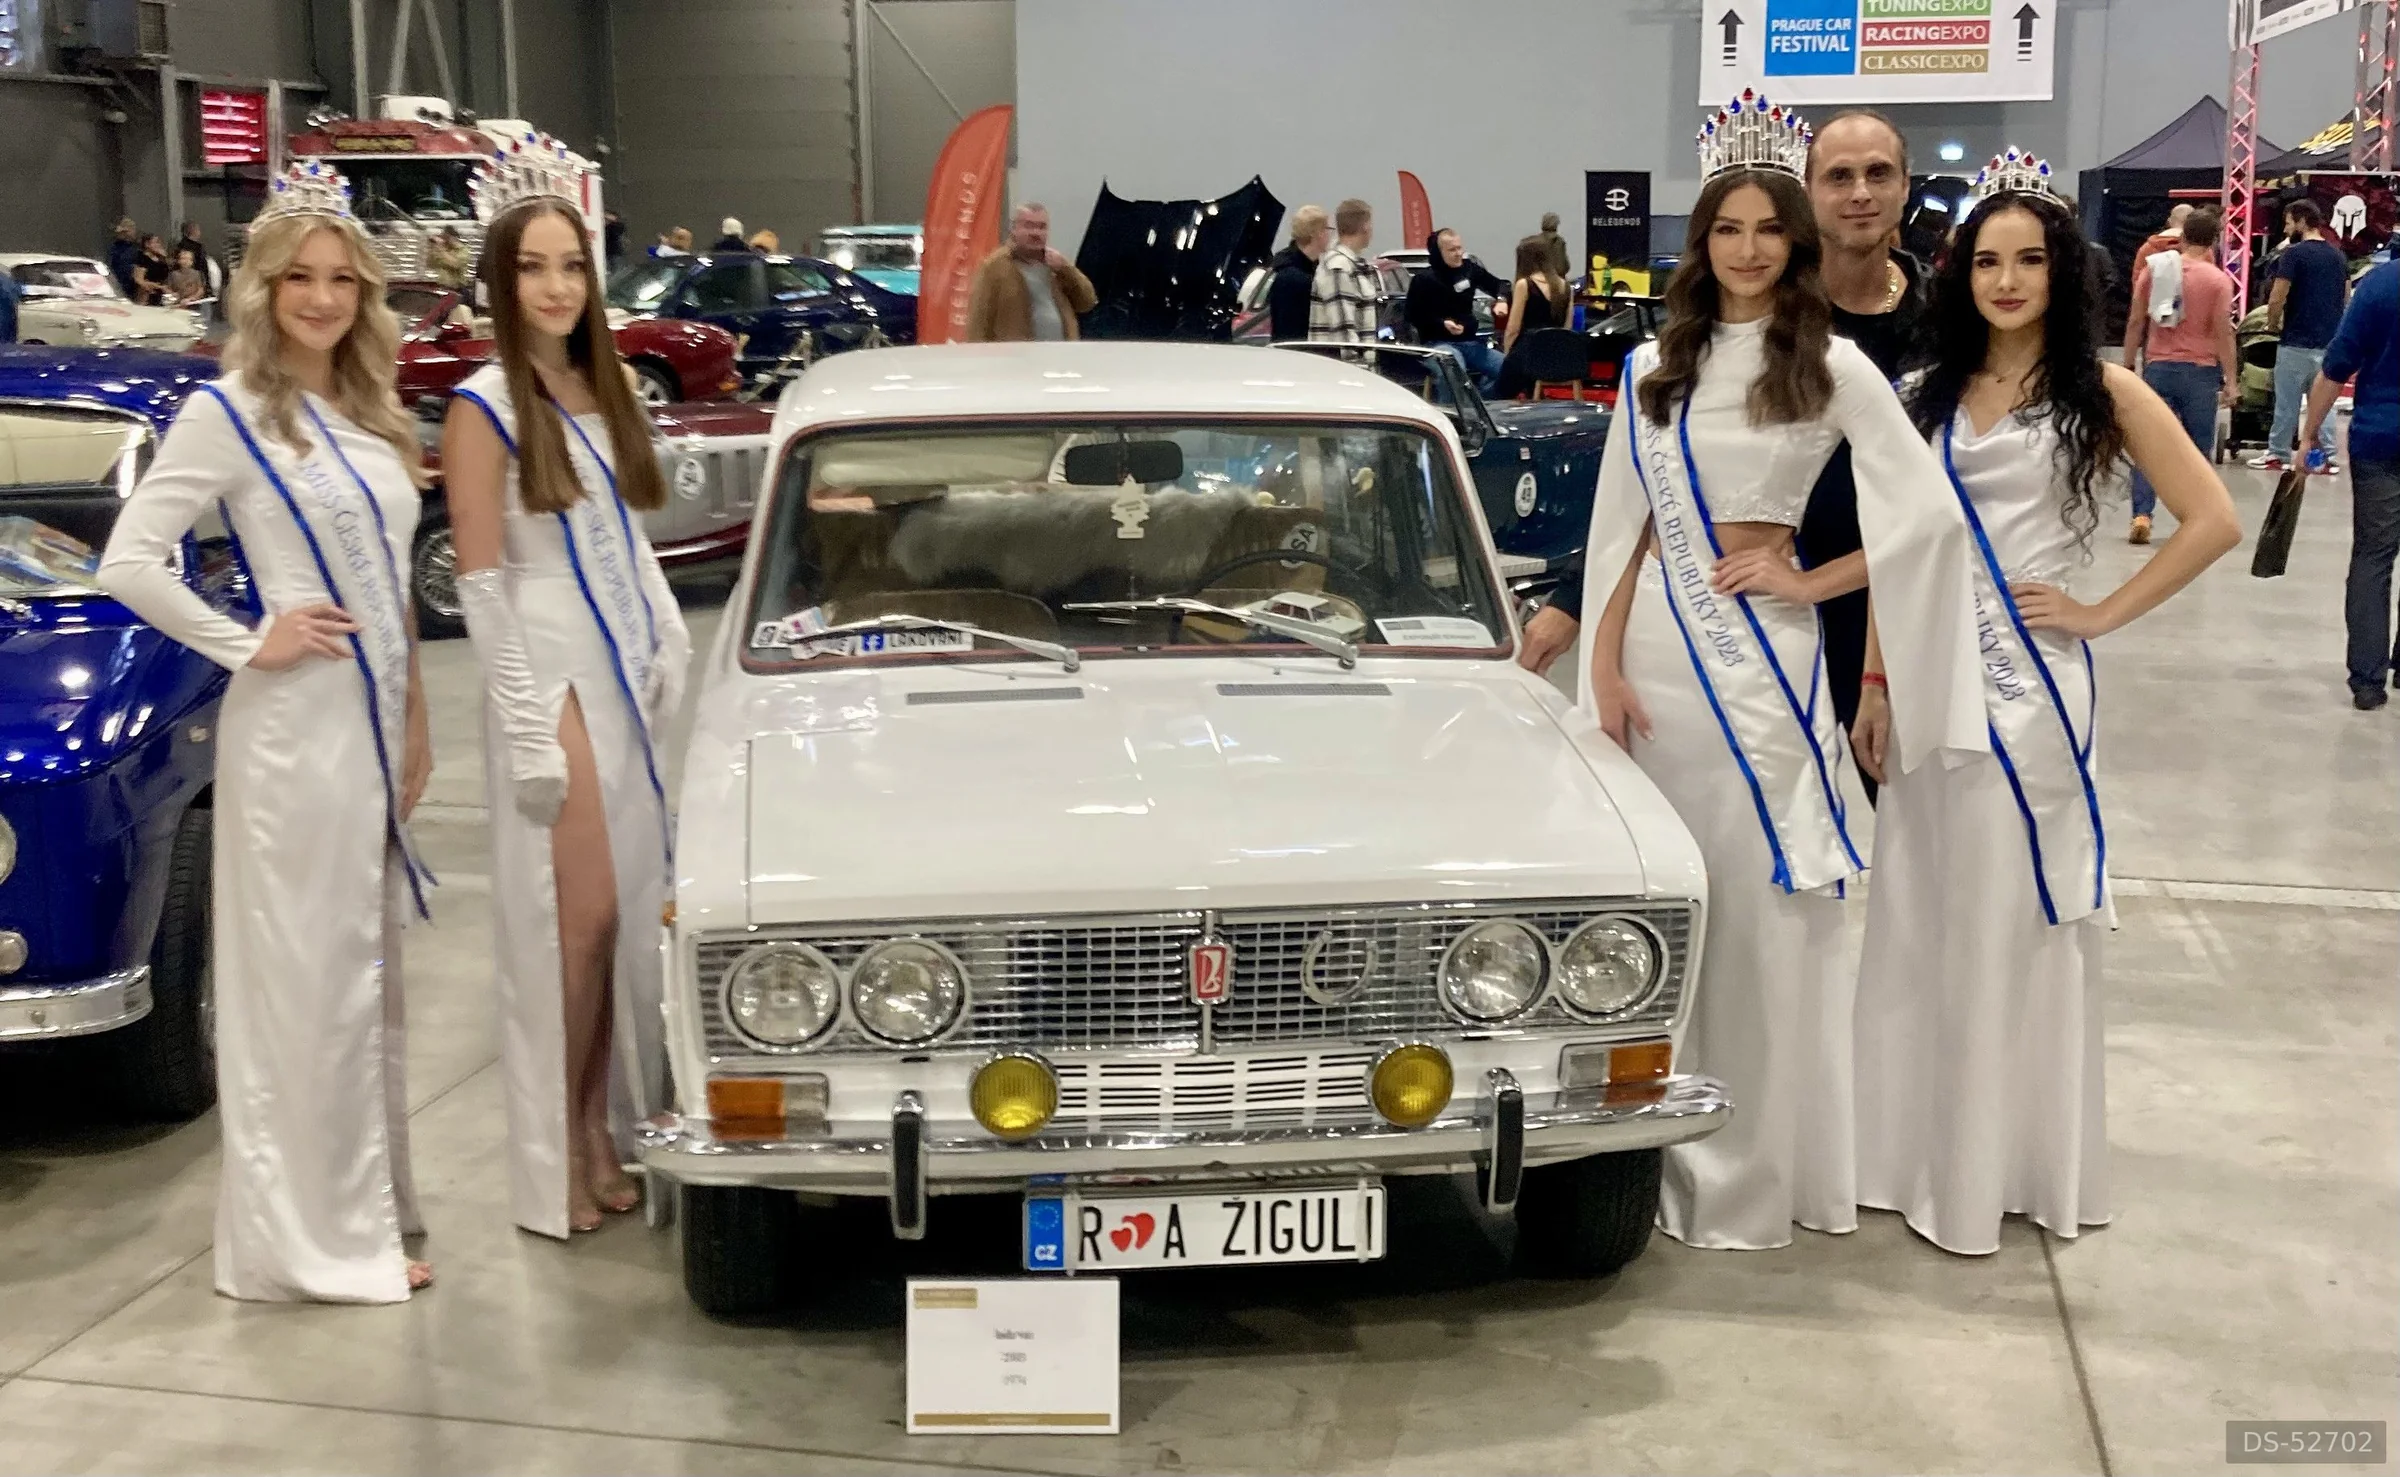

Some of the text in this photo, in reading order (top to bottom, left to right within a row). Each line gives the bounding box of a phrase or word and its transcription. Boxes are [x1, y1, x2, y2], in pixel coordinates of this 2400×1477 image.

[1867, 0, 1989, 13] TUNINGEXPO
[1771, 17, 1852, 33] PRAGUE CAR
[1865, 25, 1987, 42] RACINGEXPO
[1770, 35, 1850, 53] FESTIVAL
[1864, 53, 1986, 71] CLASSICEXPO
[1651, 450, 1683, 517] ČESKÉ
[1664, 516, 1722, 623] REPUBLIKY
[1705, 623, 1745, 668] 2023
[1986, 656, 2026, 701] 2023
[1078, 1196, 1374, 1262] R A ŽIGULI
[1034, 1245, 1058, 1261] CZ
